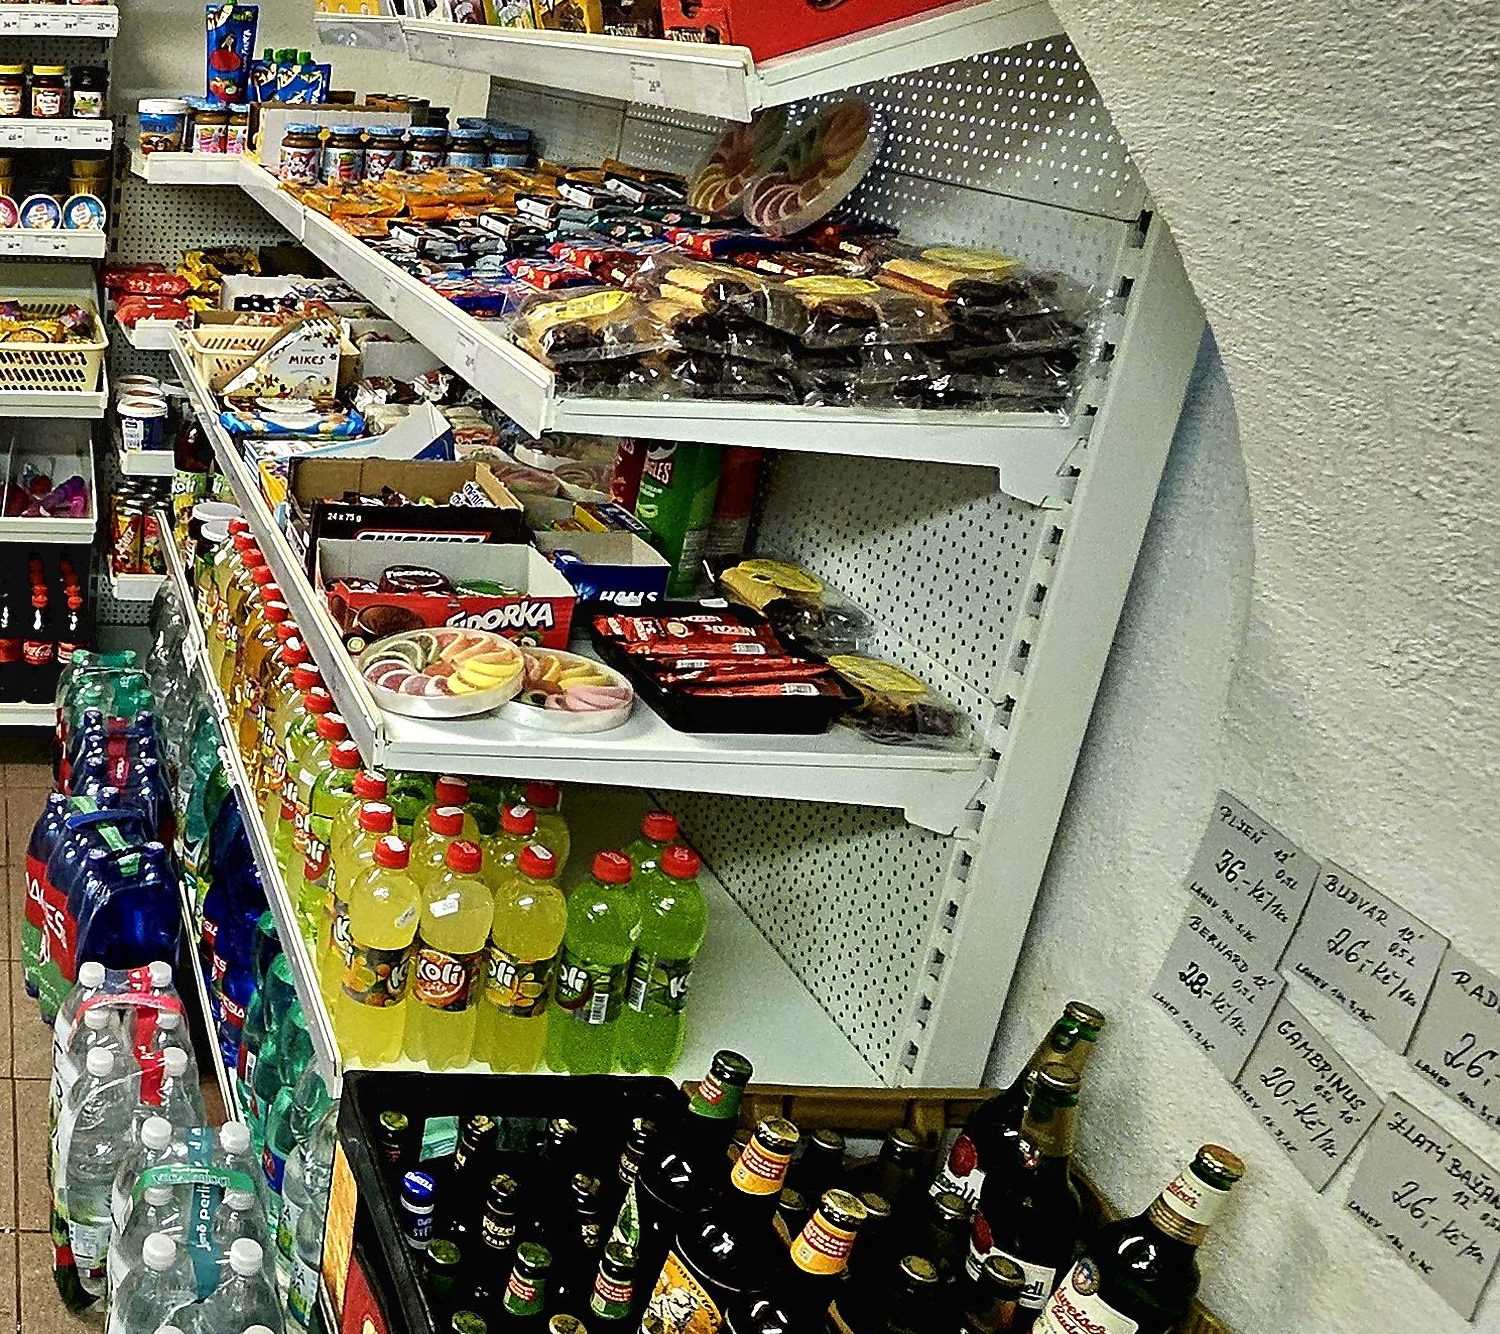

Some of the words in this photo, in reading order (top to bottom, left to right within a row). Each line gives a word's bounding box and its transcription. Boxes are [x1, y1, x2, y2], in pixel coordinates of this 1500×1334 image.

[1323, 873, 1388, 929] BUDVAR
[1188, 915, 1249, 973] BERNARD
[1275, 1018, 1367, 1112] GAMBRINUS
